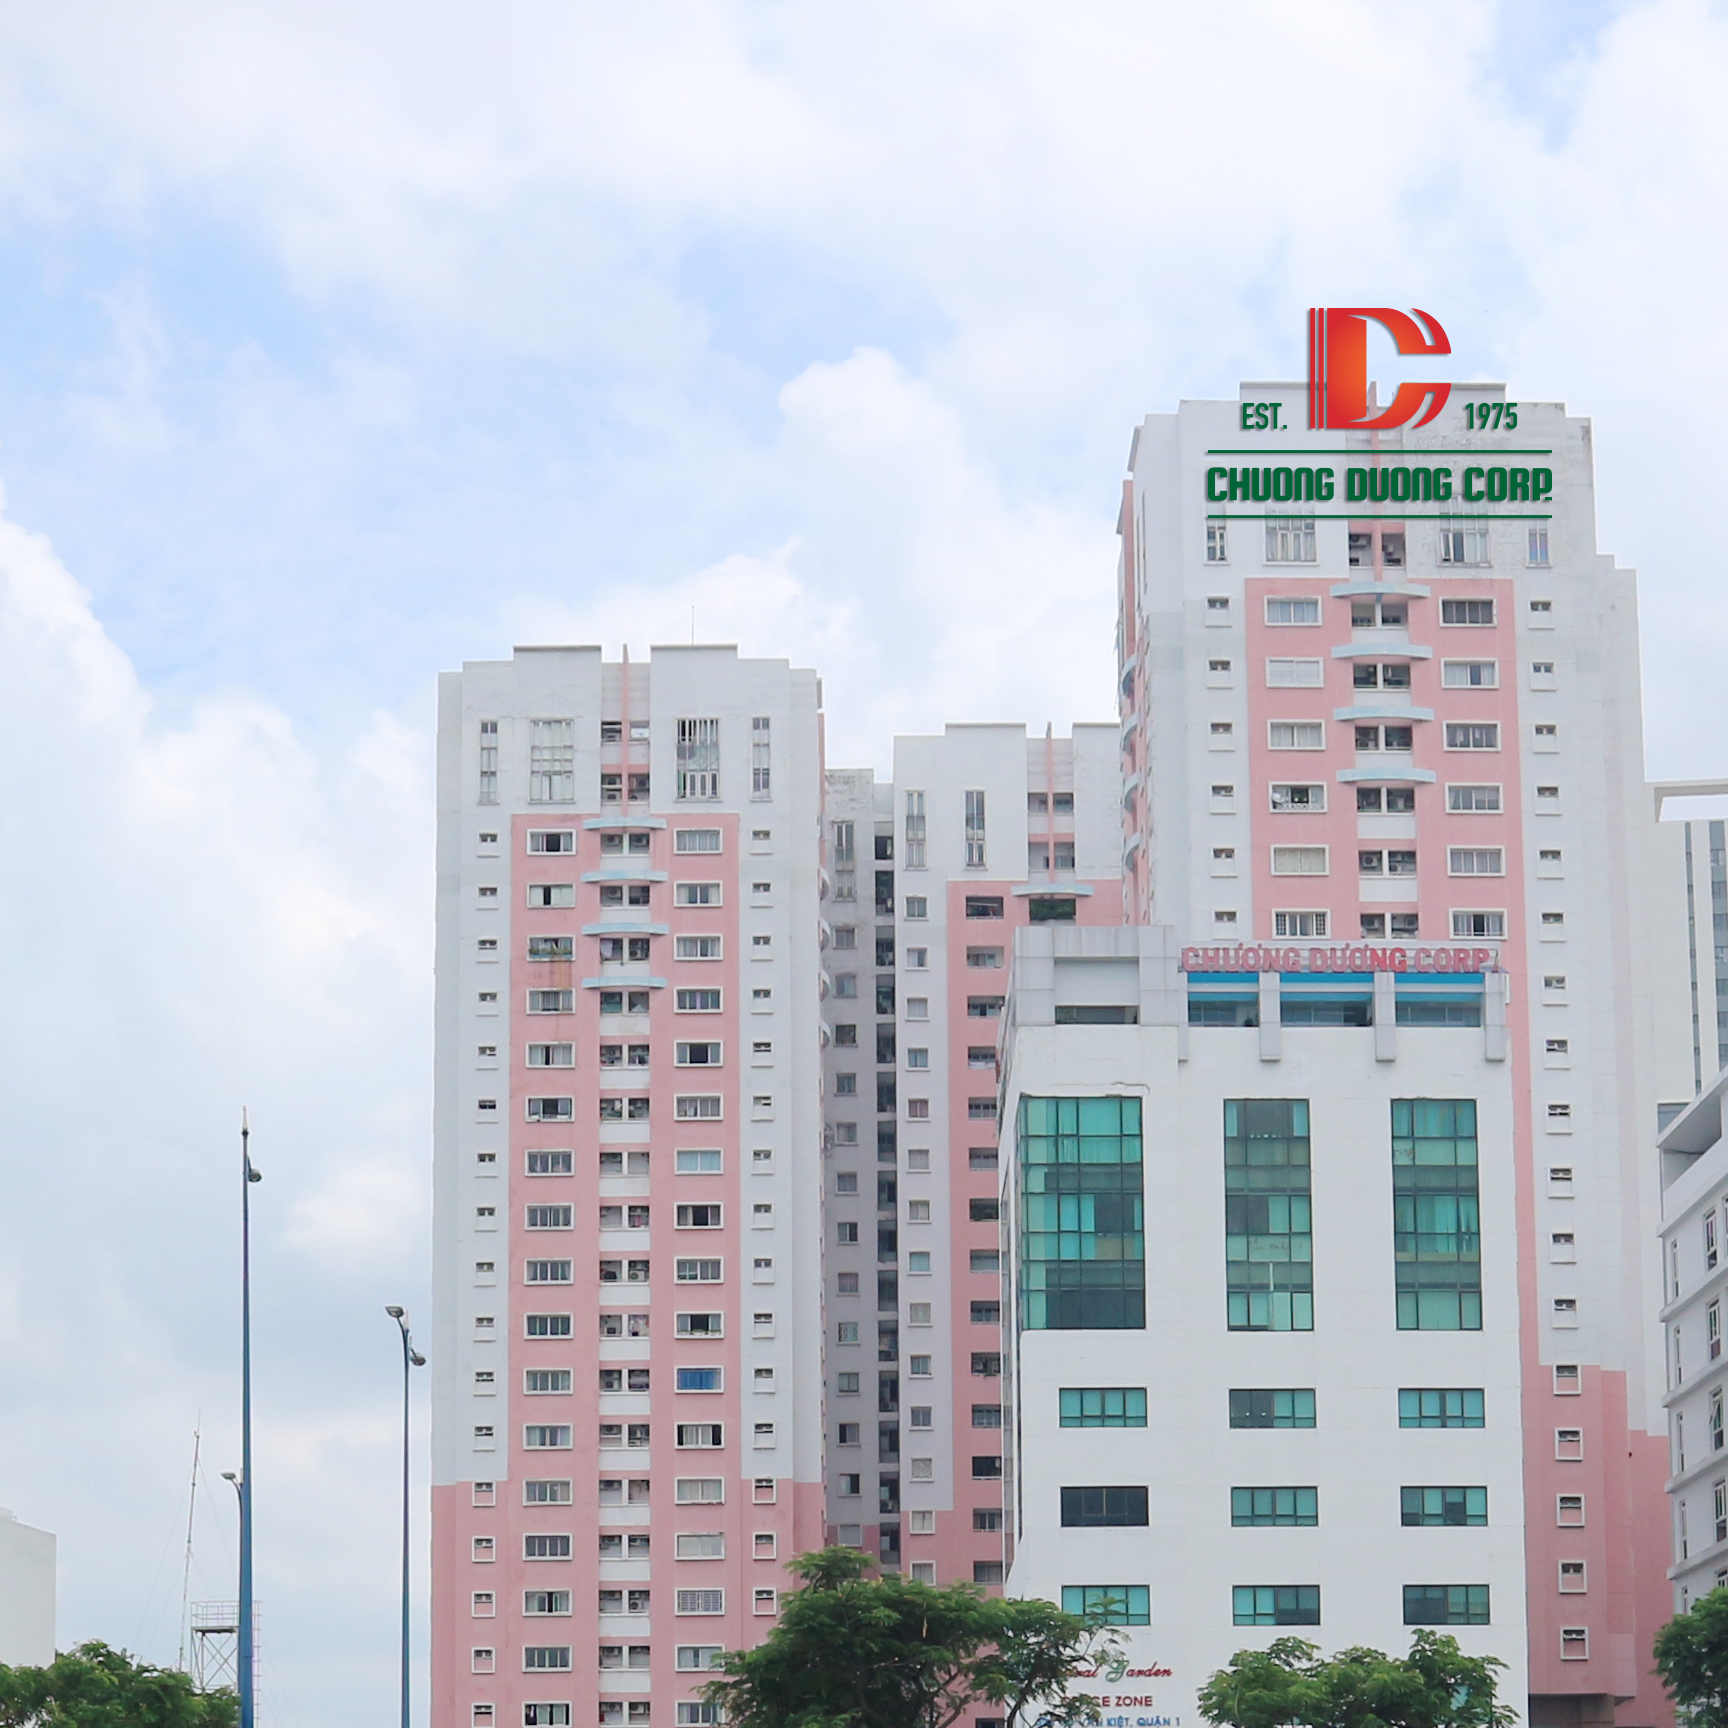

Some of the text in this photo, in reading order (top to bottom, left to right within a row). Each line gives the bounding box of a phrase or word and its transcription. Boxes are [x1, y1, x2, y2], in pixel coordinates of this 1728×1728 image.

[1182, 942, 1302, 973] CHƯƠNG
[1309, 942, 1408, 973] DƯƠNG
[1115, 1695, 1153, 1707] ZONE
